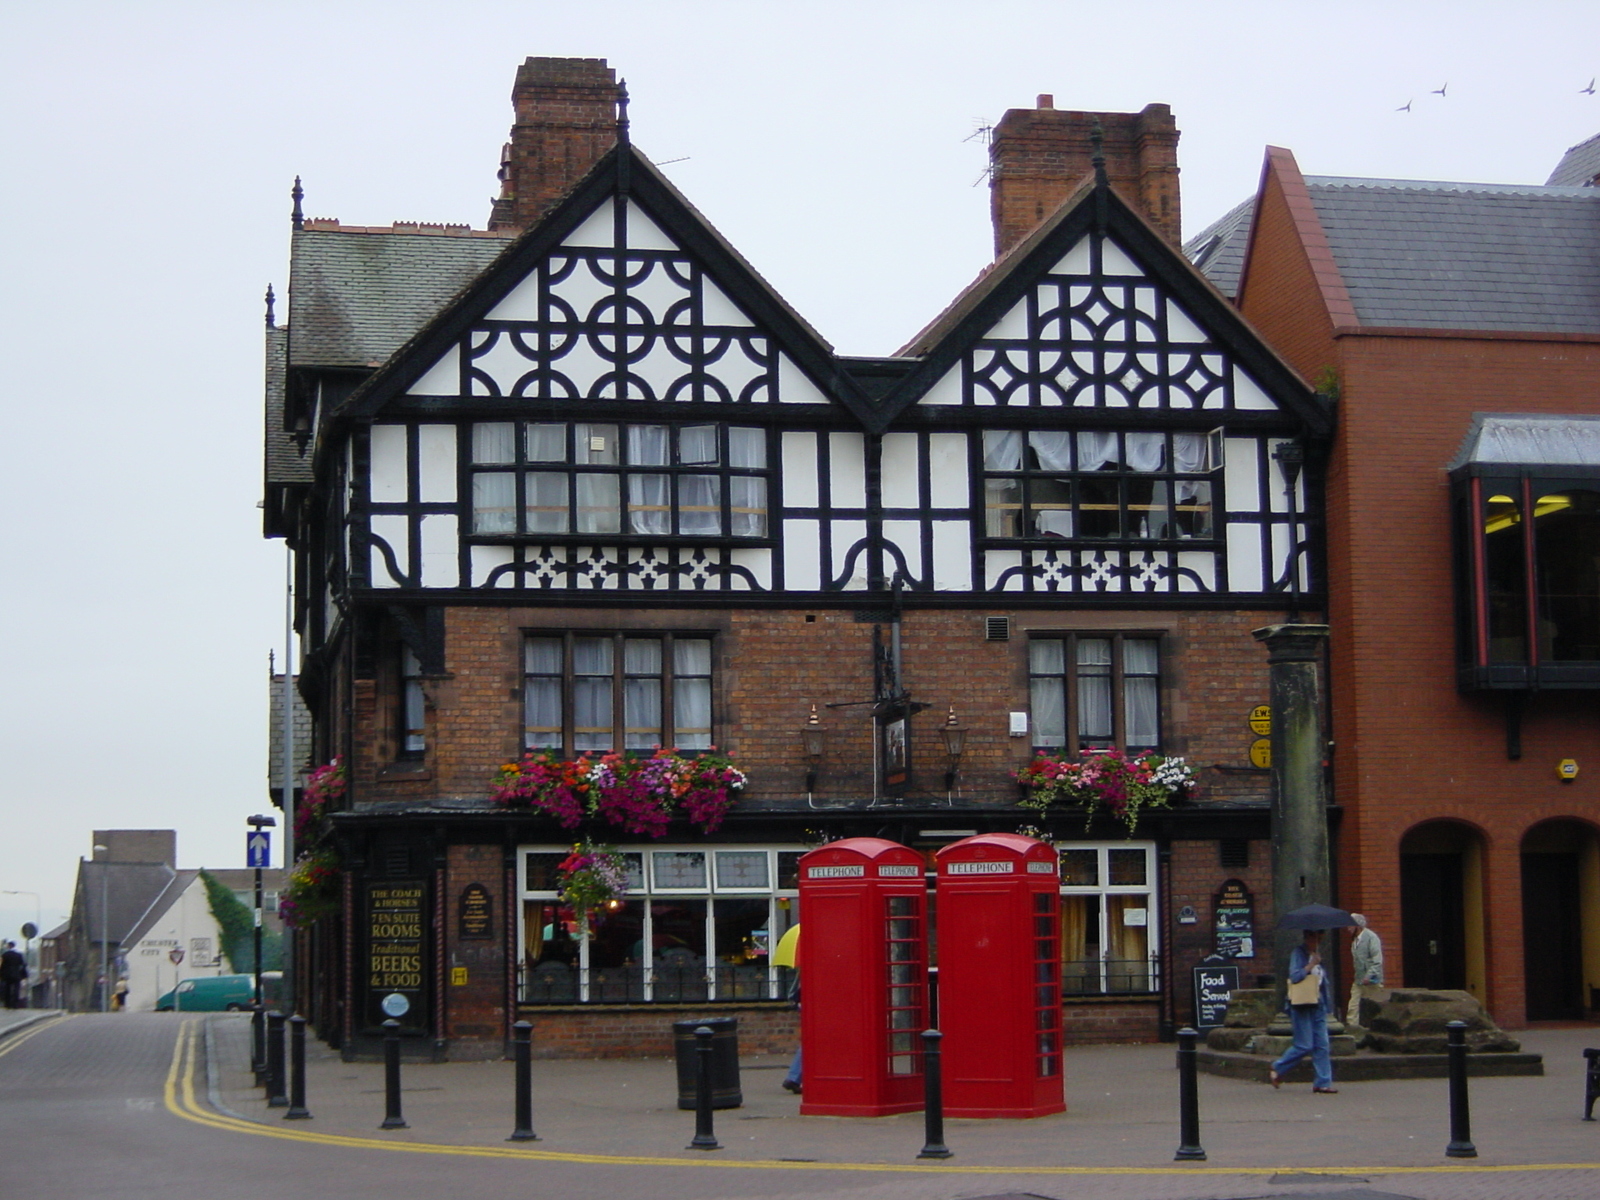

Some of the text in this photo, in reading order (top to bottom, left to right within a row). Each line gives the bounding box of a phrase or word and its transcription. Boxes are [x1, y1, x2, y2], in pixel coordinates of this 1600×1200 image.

[812, 867, 862, 877] TELEPHONE
[880, 866, 916, 875] TELEPHONE
[951, 863, 1011, 873] TELEPHONE
[371, 889, 421, 898] THE COACH
[374, 898, 418, 907] & HORSES
[371, 913, 420, 923] 7 EN SUITE
[372, 924, 421, 937] ROOMS
[371, 943, 420, 954] Traditional
[372, 956, 420, 972] BEERS
[371, 973, 421, 986] & FOOD
[454, 969, 465, 983] H
[1200, 972, 1225, 990] Food
[1201, 988, 1230, 1002] Served
